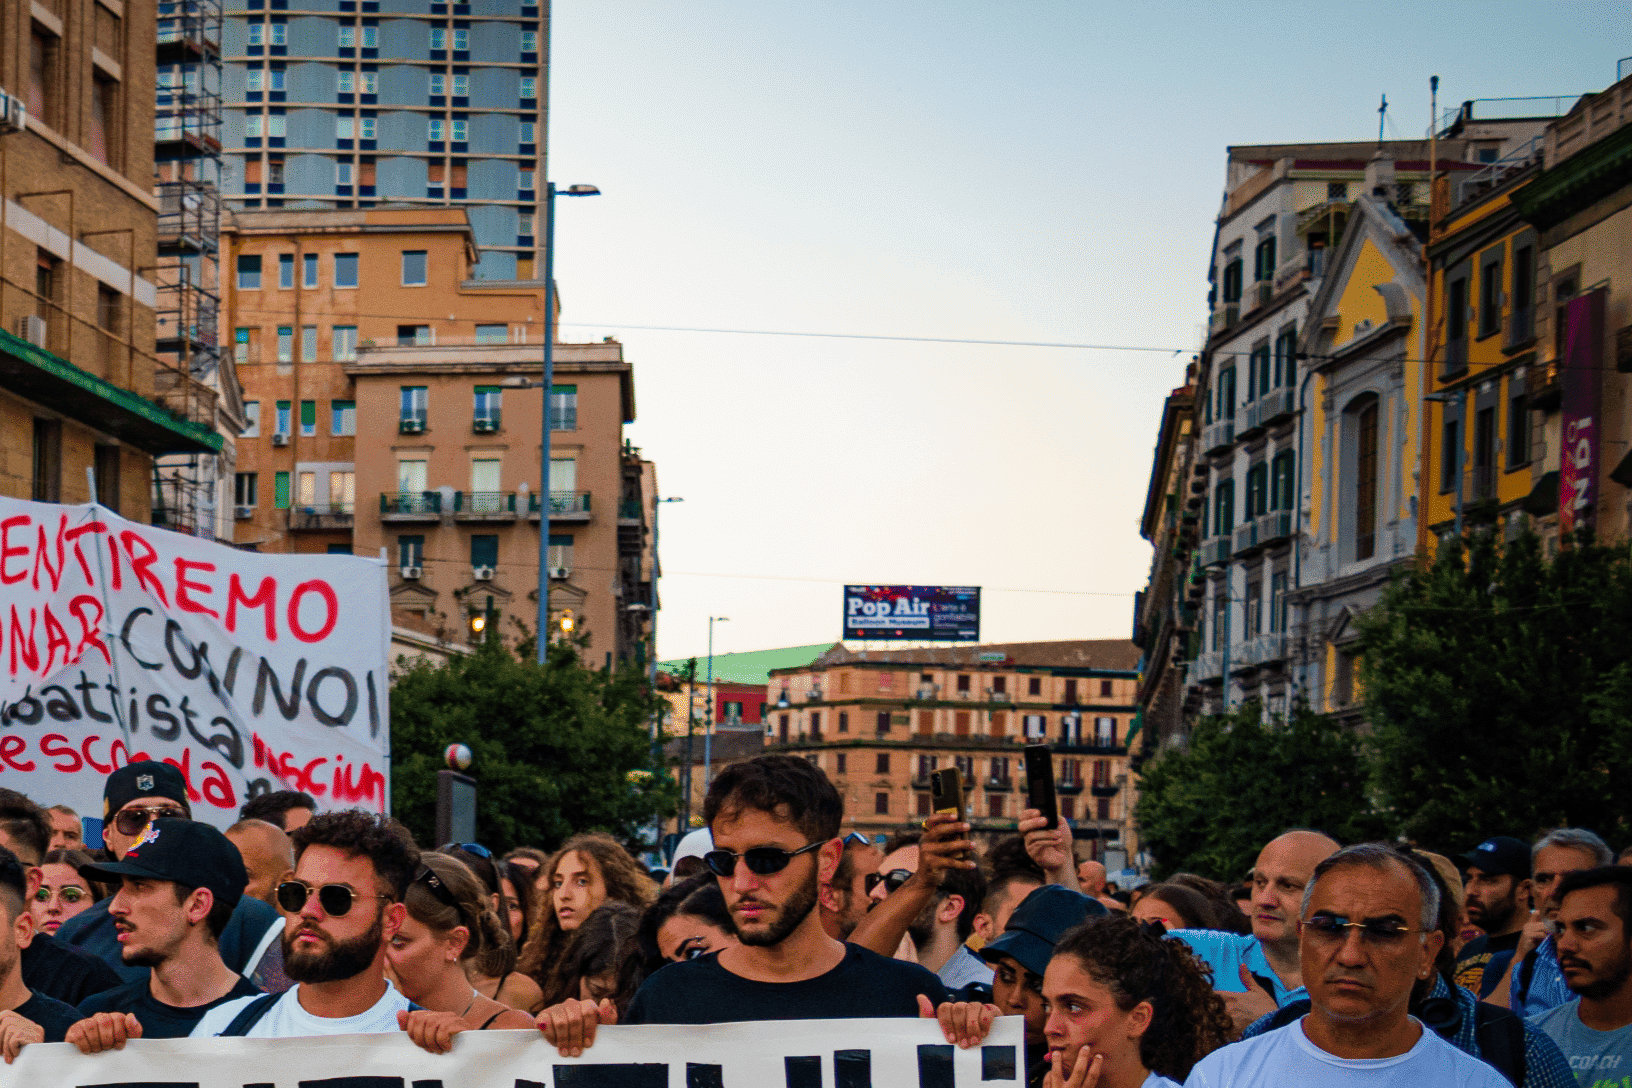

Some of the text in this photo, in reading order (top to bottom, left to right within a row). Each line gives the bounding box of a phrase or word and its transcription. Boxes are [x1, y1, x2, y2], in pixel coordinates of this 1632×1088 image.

[848, 596, 930, 617] Pop Air
[252, 656, 381, 739] NOI
